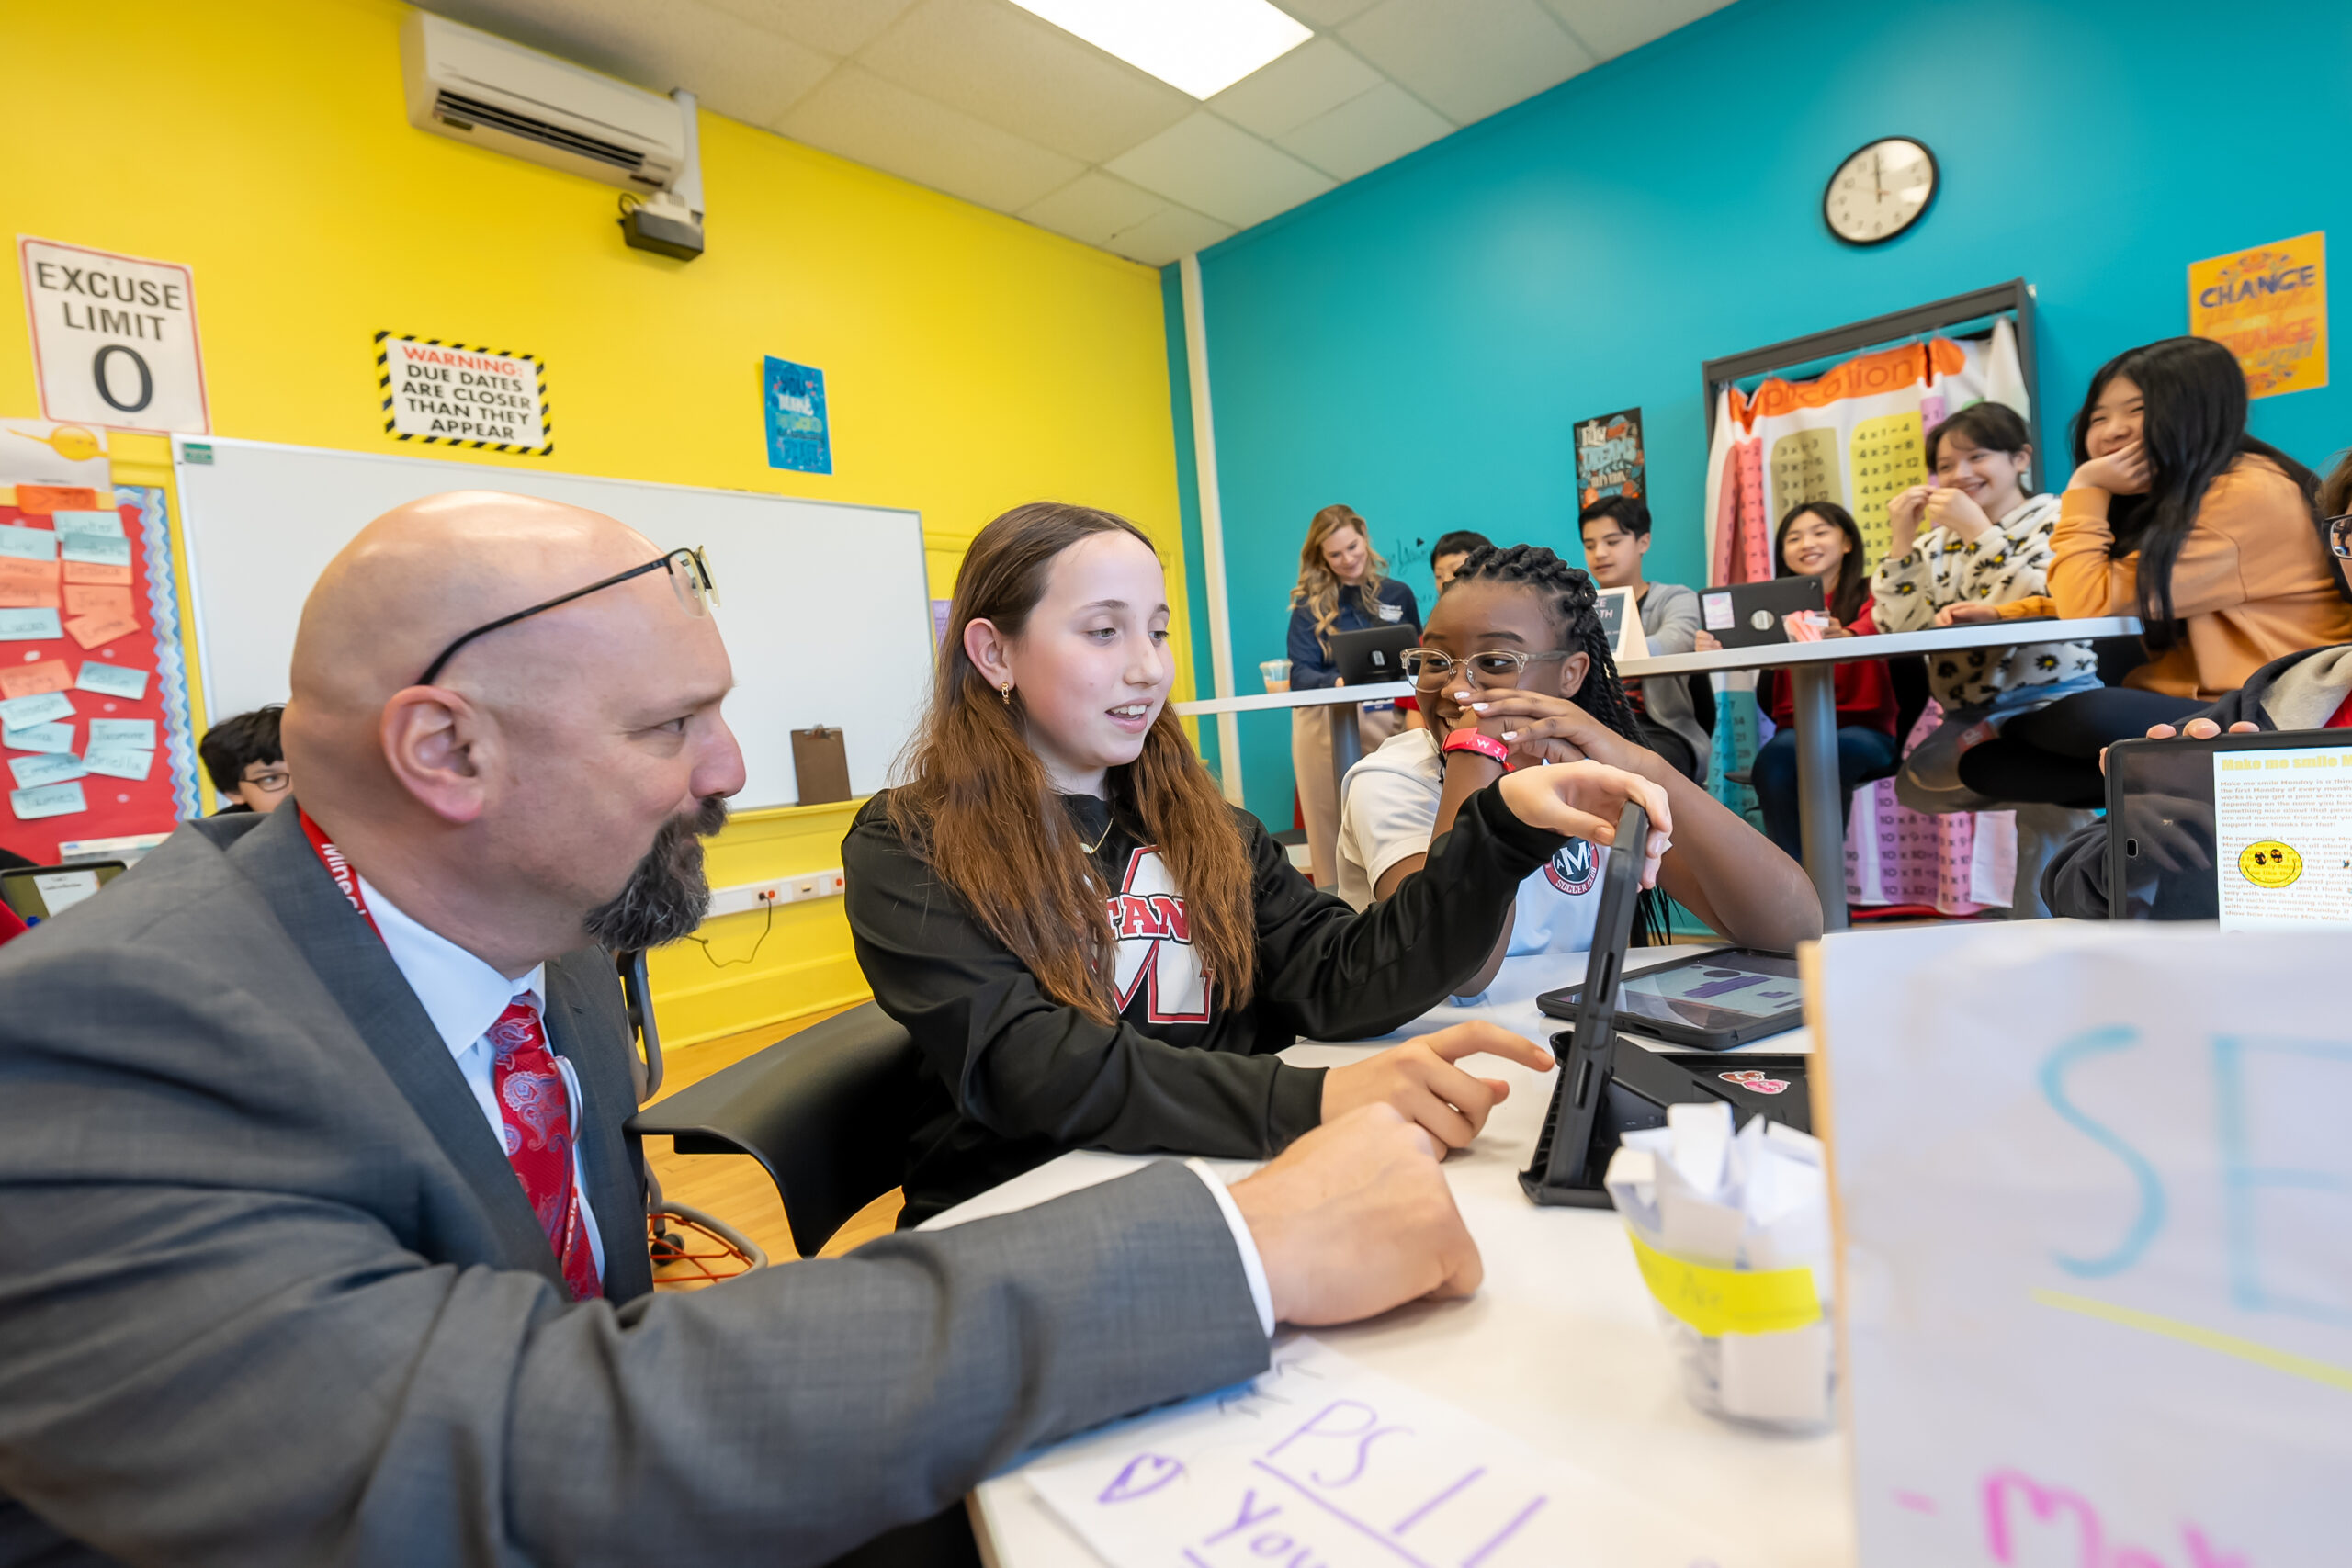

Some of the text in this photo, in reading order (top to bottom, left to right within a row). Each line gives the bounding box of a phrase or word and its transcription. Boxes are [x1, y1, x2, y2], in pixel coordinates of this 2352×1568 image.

[37, 261, 182, 310] EXCUSE
[2199, 265, 2316, 308] CHANGE
[62, 301, 166, 341] LIMIT
[402, 346, 523, 378] WARNING:
[406, 364, 523, 393] DUE DATES
[402, 381, 531, 410] ARE CLOSER
[405, 397, 529, 425] THAN THEY
[431, 419, 515, 440] APPEAR
[1859, 430, 1866, 440] 4
[1859, 449, 1867, 458] 4
[1860, 468, 1867, 477] 4
[1861, 486, 1869, 495] 4
[2222, 760, 2261, 770] Make
[2265, 759, 2290, 770] me
[2293, 756, 2337, 768] smile
[1555, 879, 1588, 895] SOCCER
